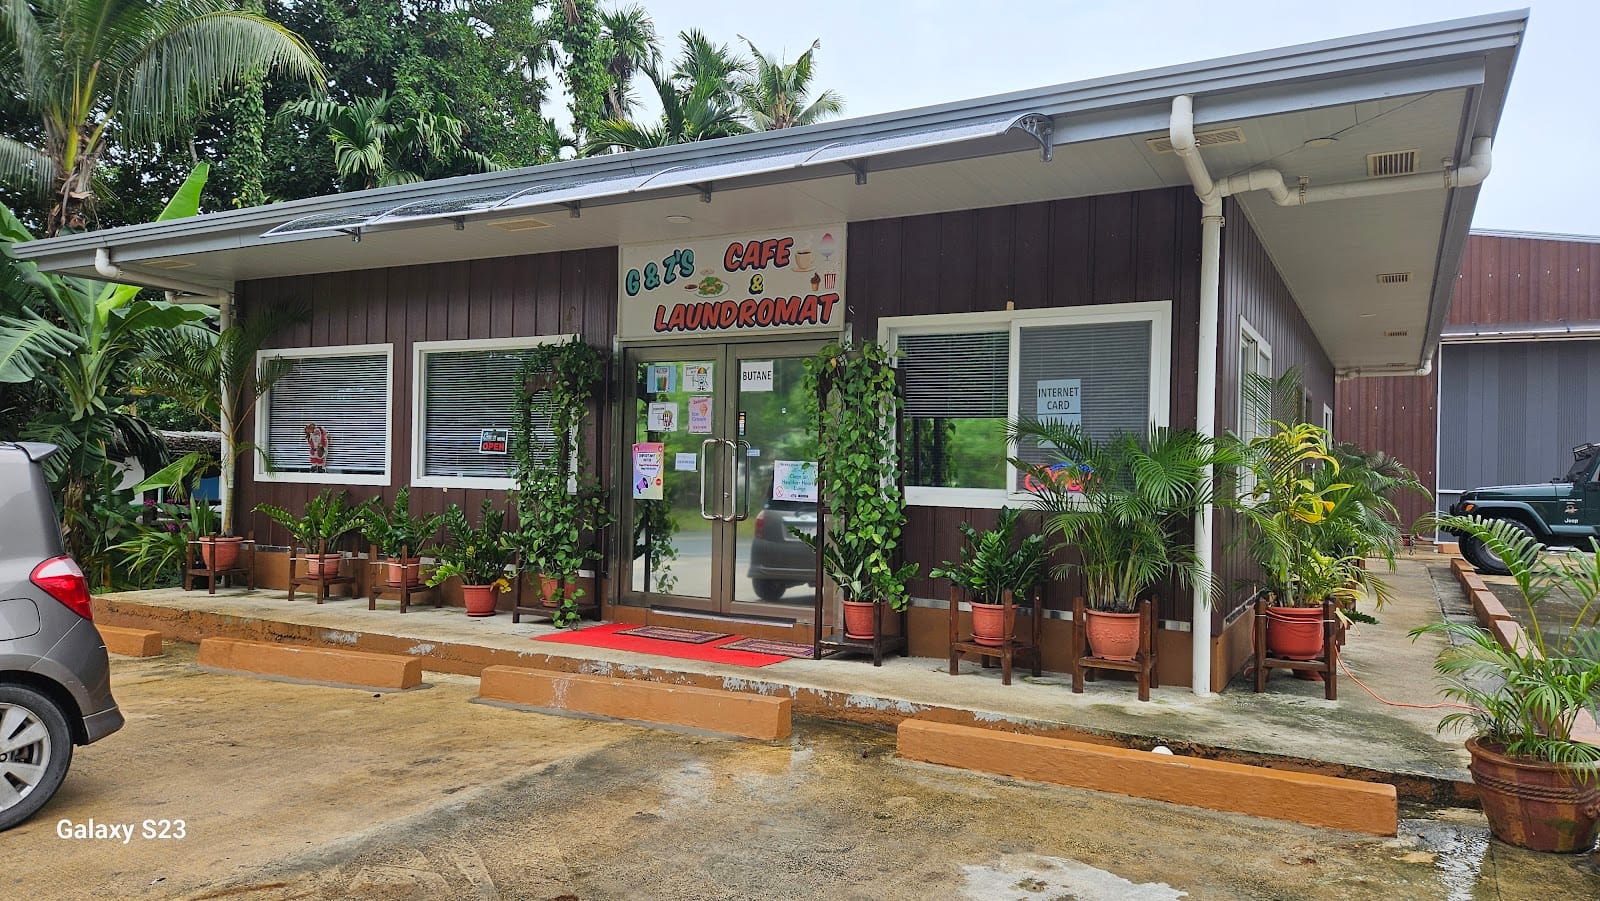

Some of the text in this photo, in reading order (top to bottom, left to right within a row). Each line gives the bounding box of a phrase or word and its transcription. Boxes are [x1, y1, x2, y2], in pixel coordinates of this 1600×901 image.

[723, 237, 794, 272] CAFE
[626, 248, 695, 296] G & Z'S
[748, 273, 764, 294] &
[653, 293, 840, 332] LAUNDROMAT
[742, 370, 772, 381] BUTANE
[1038, 387, 1080, 398] INTERNET
[1047, 400, 1070, 410] CARD
[483, 442, 504, 451] OPEN
